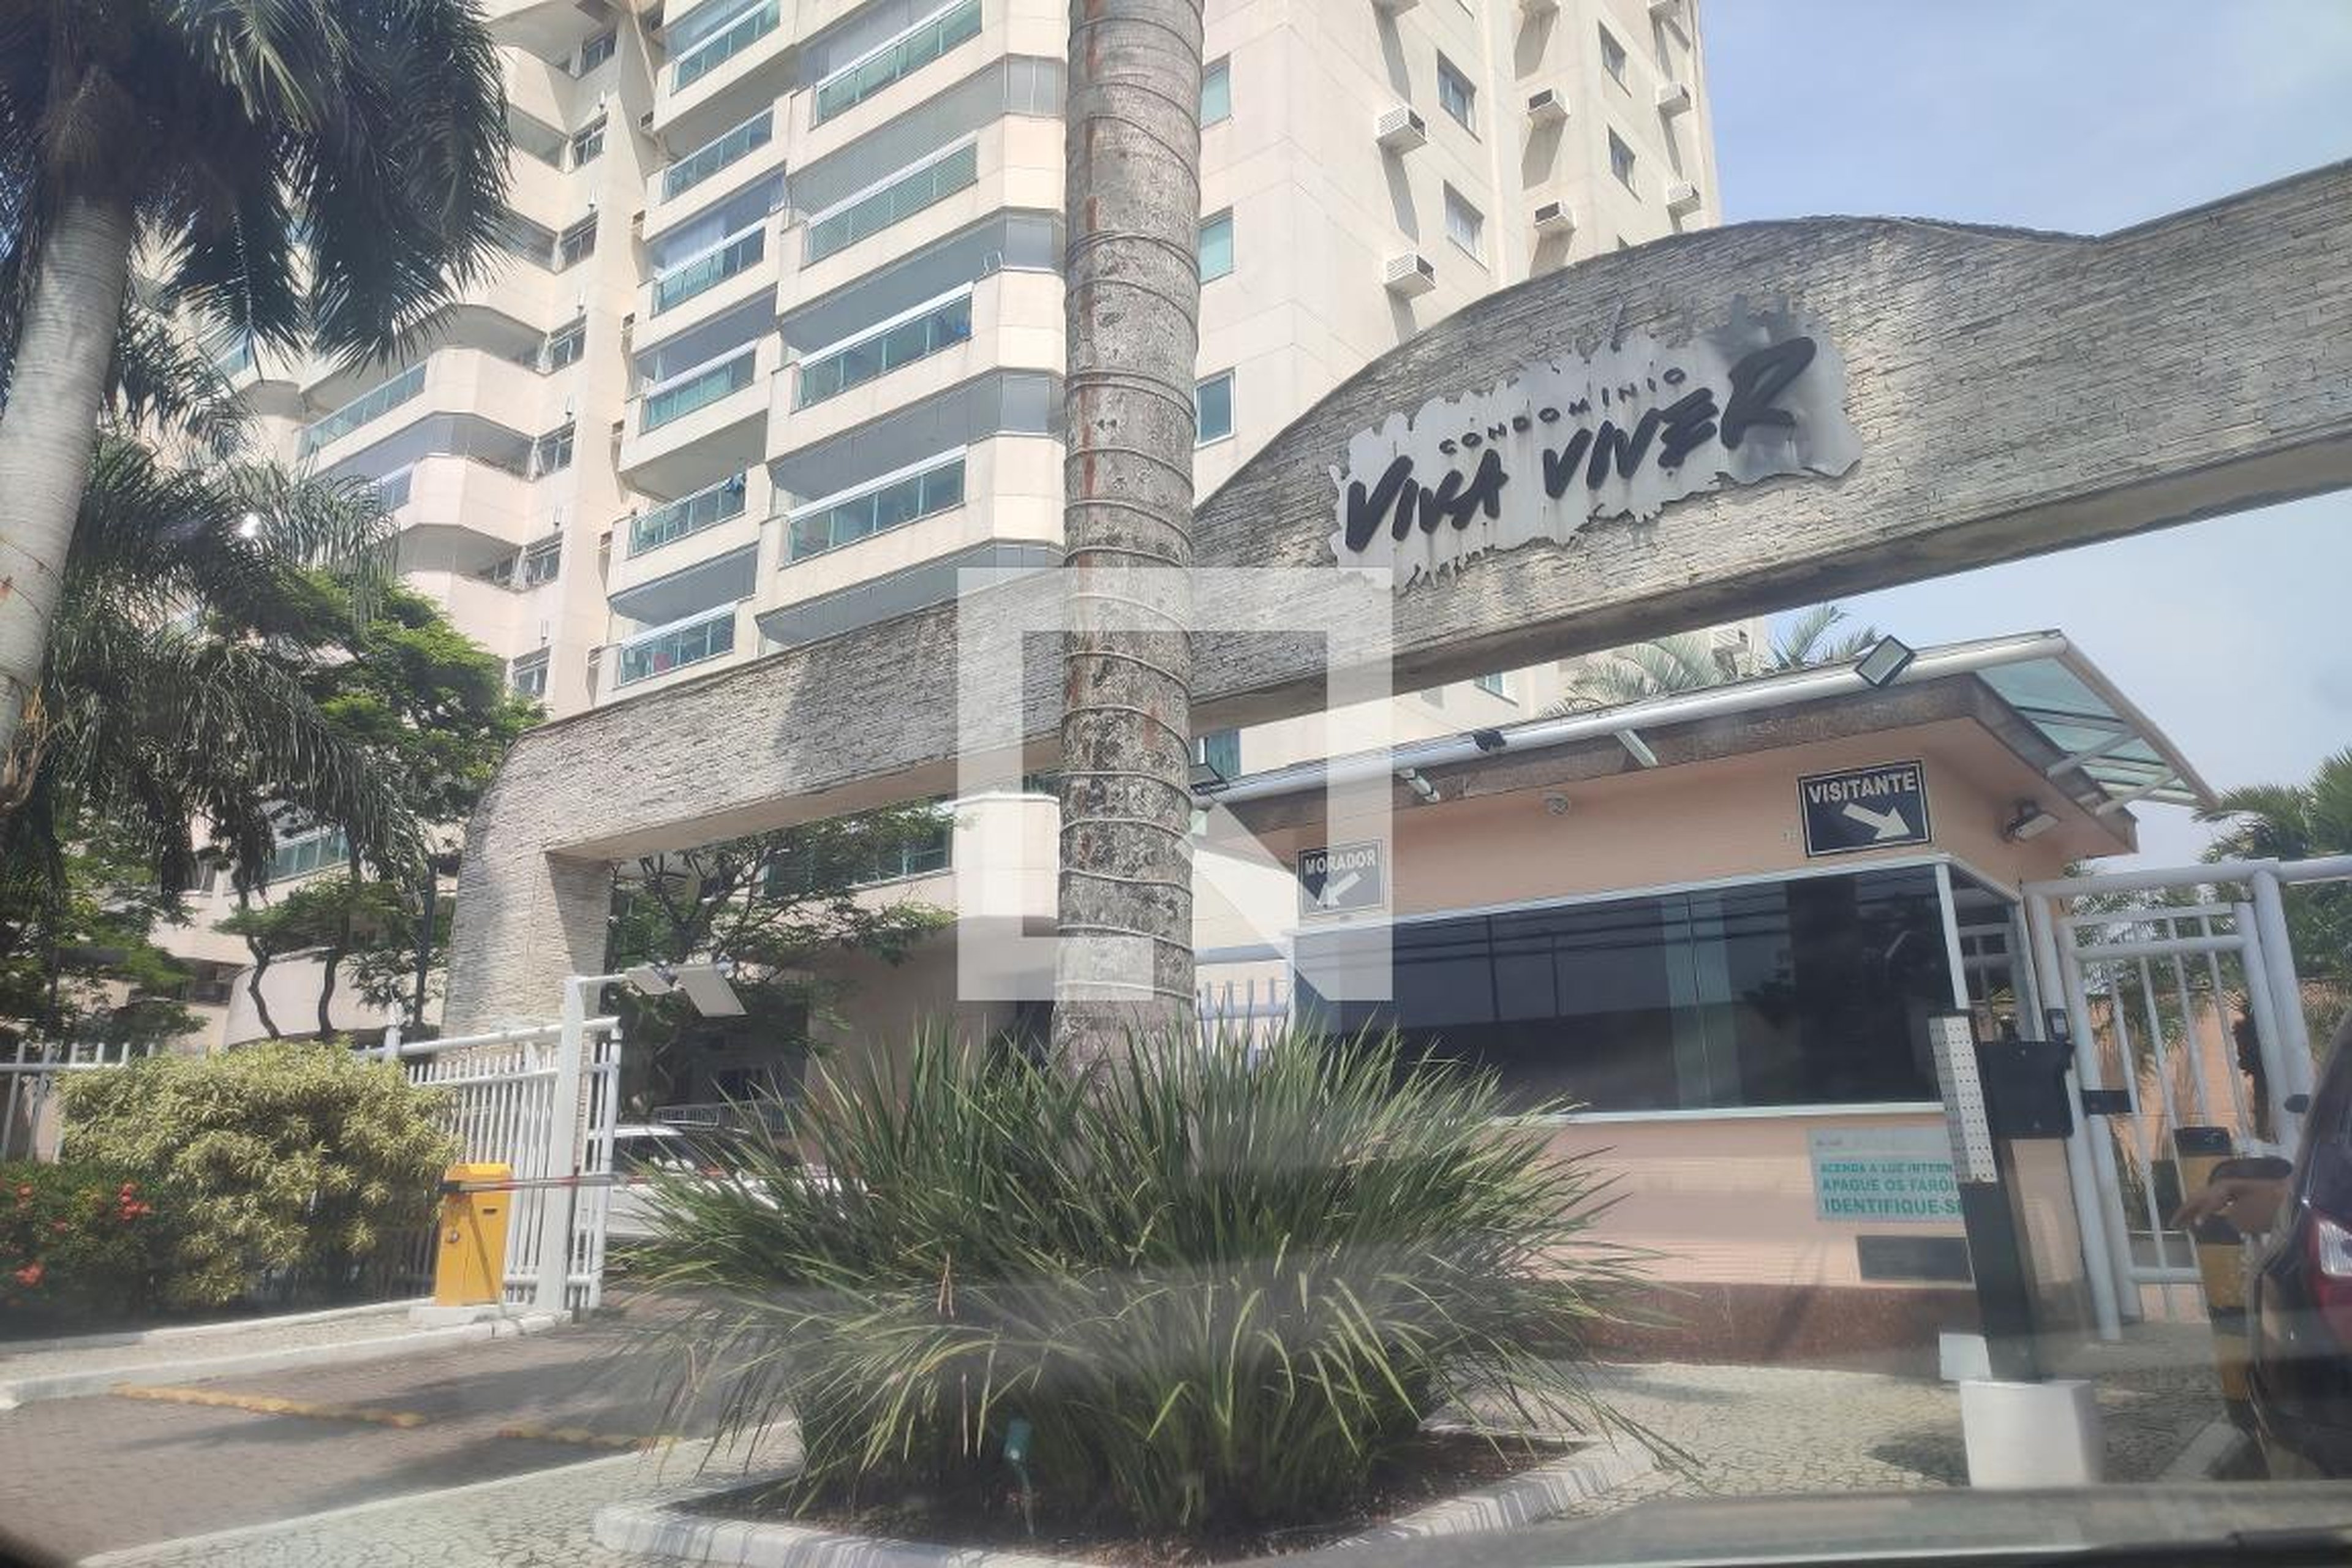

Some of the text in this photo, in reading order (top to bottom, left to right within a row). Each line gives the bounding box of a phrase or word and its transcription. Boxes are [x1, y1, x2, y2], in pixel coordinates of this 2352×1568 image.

[1345, 336, 1818, 553] VIVA VIVER
[1808, 771, 1917, 804] VISITANTE
[1305, 849, 1376, 875] MORADOR
[1822, 1163, 1866, 1173] ACENDA
[1868, 1163, 1878, 1173] A
[1907, 1163, 1953, 1173] INTERN
[1823, 1178, 1880, 1191] APAGUE
[1883, 1178, 1905, 1191] OS
